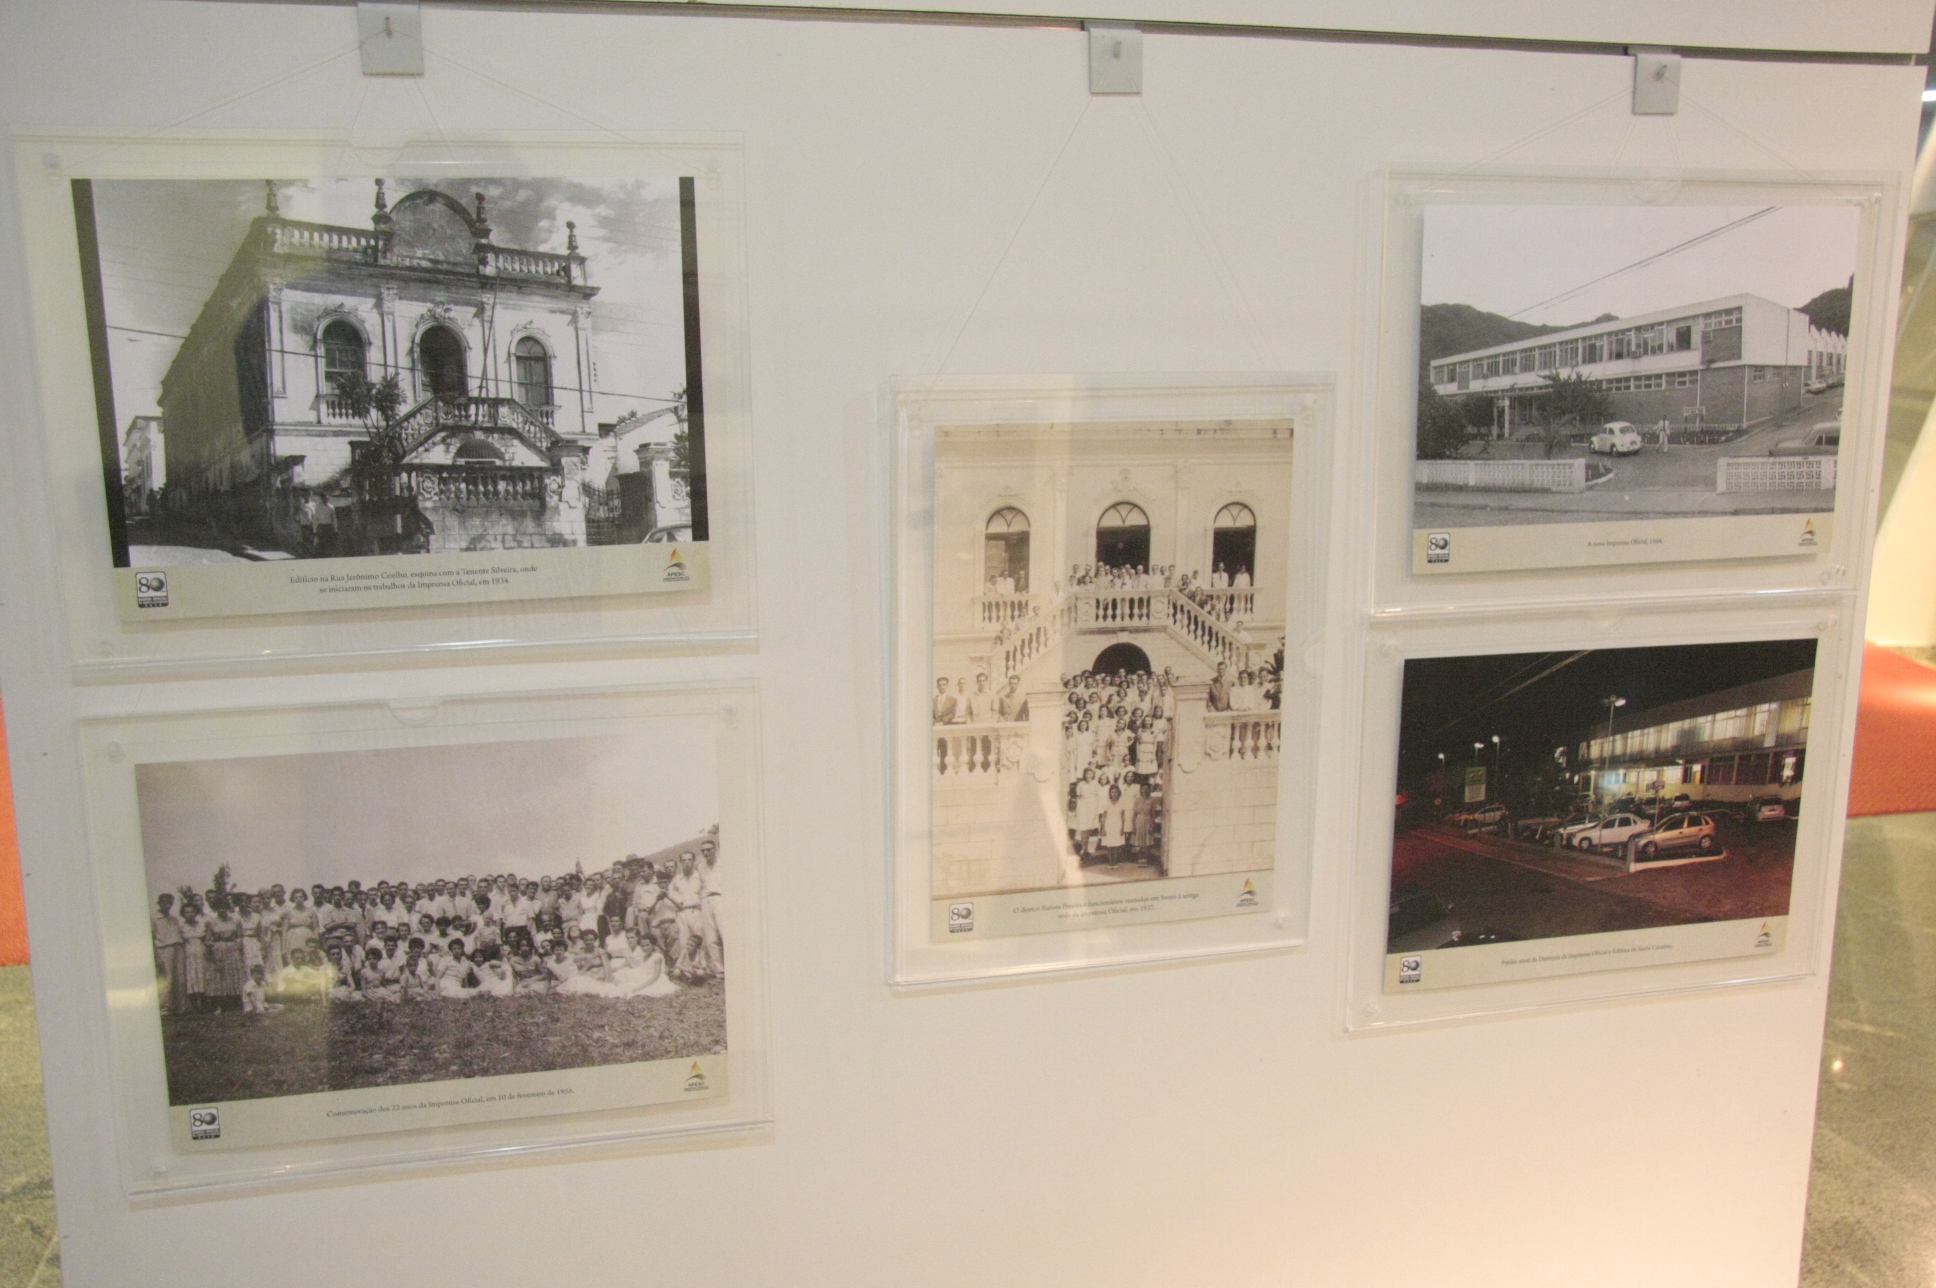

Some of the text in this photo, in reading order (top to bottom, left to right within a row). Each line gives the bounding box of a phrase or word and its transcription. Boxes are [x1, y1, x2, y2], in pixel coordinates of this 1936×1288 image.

[346, 574, 380, 583] Jerônimo
[381, 571, 408, 580] Coelho,
[410, 571, 438, 579] esquina
[491, 566, 519, 574] Silveira,
[373, 582, 406, 590] trabalhos
[418, 580, 450, 590] Imprensa
[452, 578, 478, 587] Oficial,
[326, 1107, 377, 1118] Comemoração
[428, 1100, 460, 1109] Imprensa
[460, 1096, 485, 1104] Oficial,
[517, 1091, 546, 1099] fevereiro
